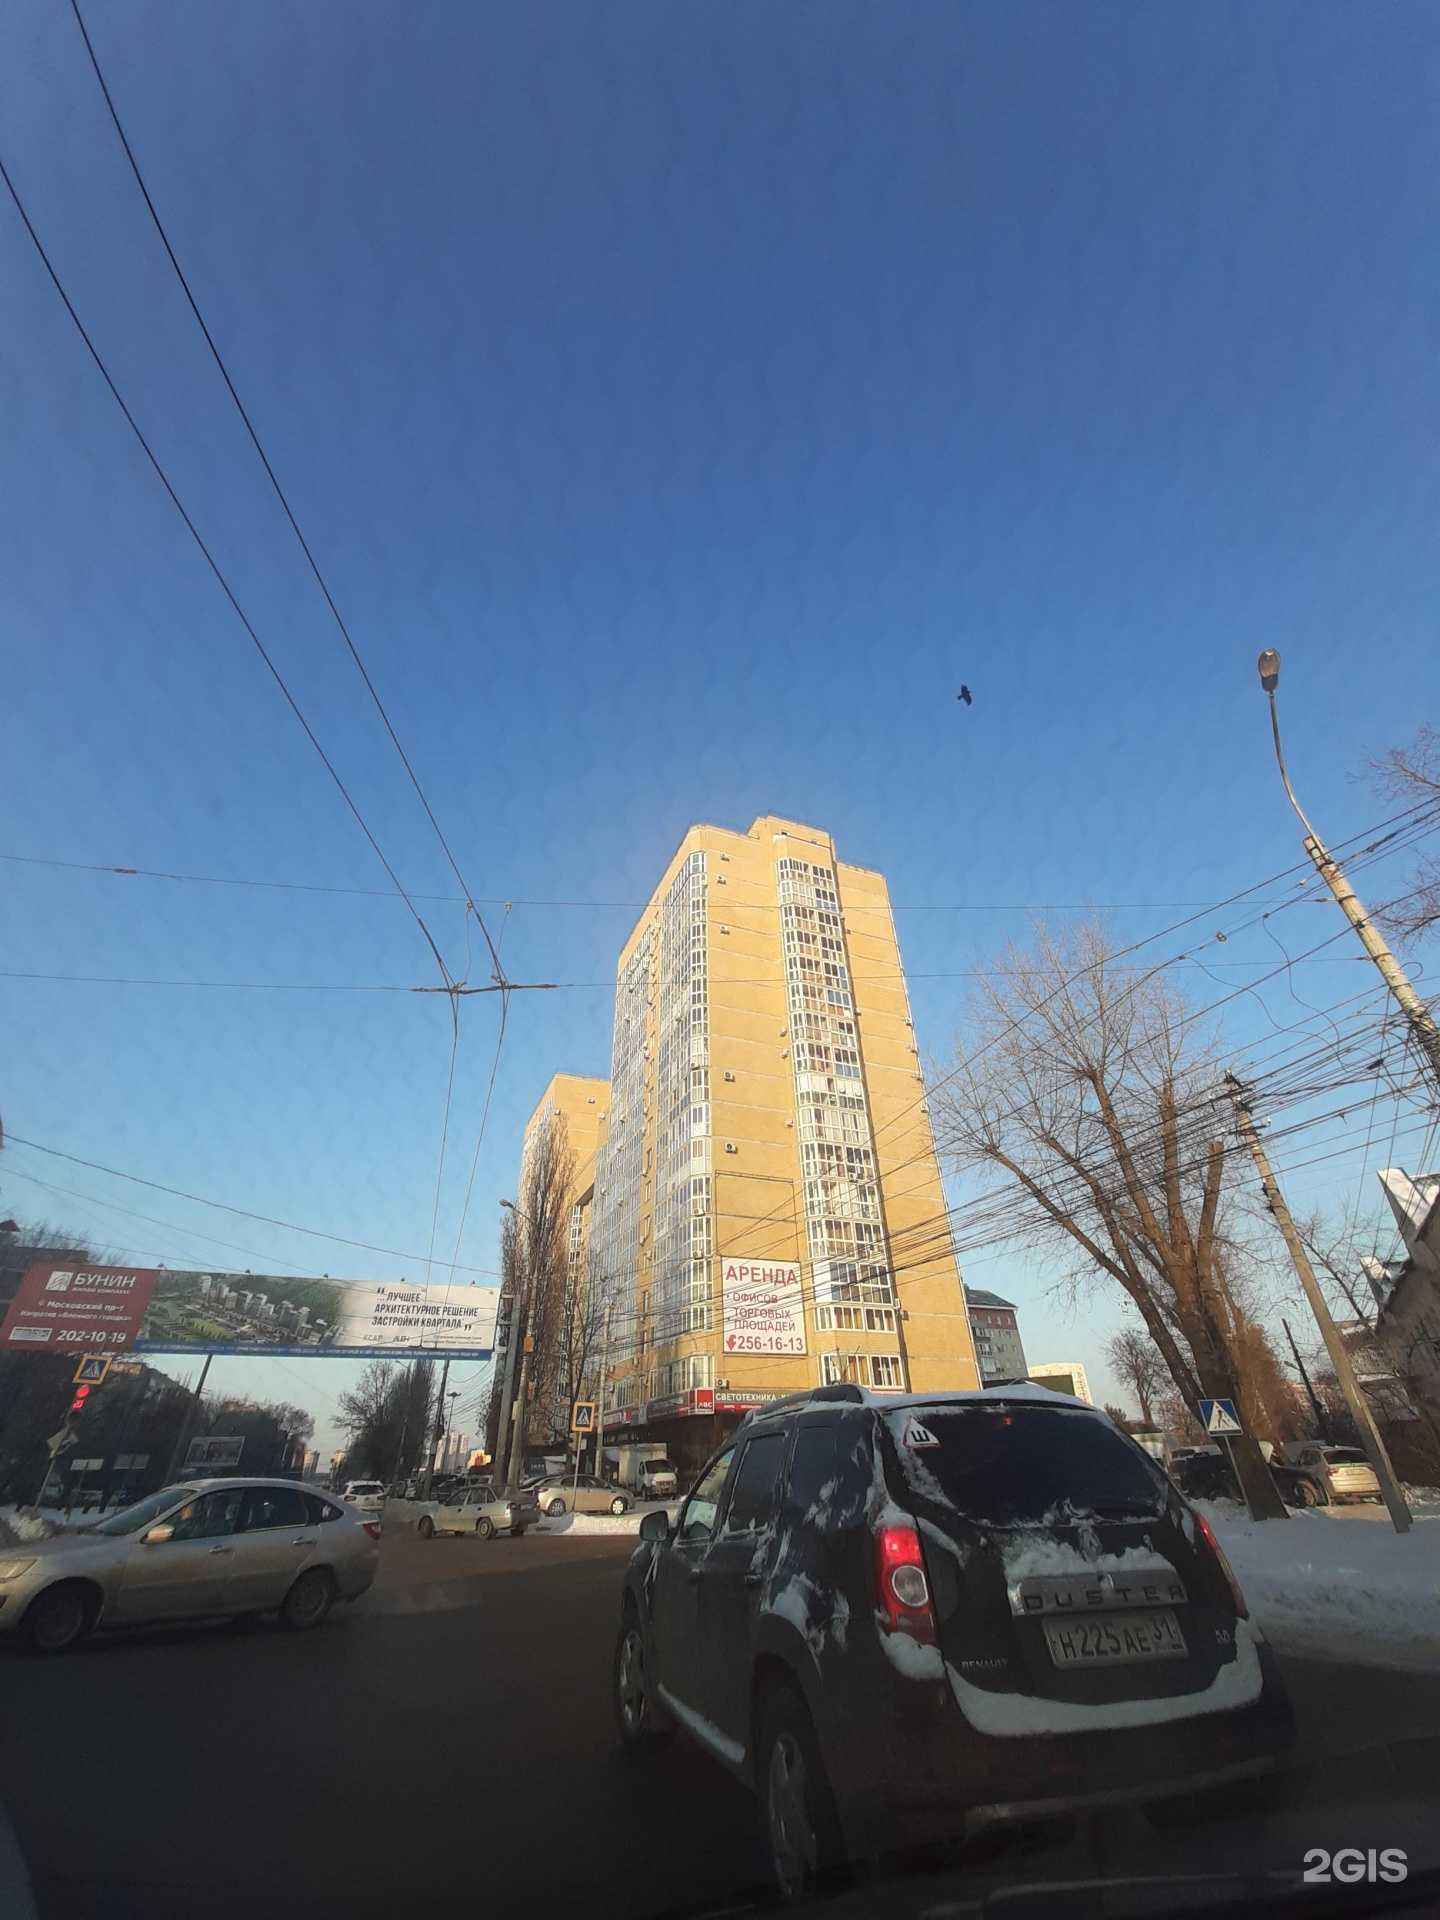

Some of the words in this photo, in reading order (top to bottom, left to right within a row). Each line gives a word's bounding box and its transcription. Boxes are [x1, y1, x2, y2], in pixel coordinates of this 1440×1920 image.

[74, 1272, 136, 1288] БУНИН
[726, 1265, 798, 1287] АРЕНДА
[733, 1292, 778, 1304] ОФИСОВ
[374, 1303, 441, 1316] АРХИТЕКТУРНОЕ
[441, 1306, 480, 1317] РЕШЕНИЕ
[734, 1307, 791, 1320] ТОРГОВЫХ
[371, 1315, 420, 1327] ЗАСТРОЙКИ
[420, 1317, 462, 1329] КВАРТАЛА
[734, 1319, 796, 1333] ПЛОЩАДЕЙ
[56, 1329, 127, 1344] 202-10-19
[737, 1335, 804, 1352] 256-16-13
[715, 1392, 777, 1402] СВЕТОТЕХНИКА
[910, 1430, 931, 1443] Ш
[1022, 1584, 1188, 1612] DUSTER
